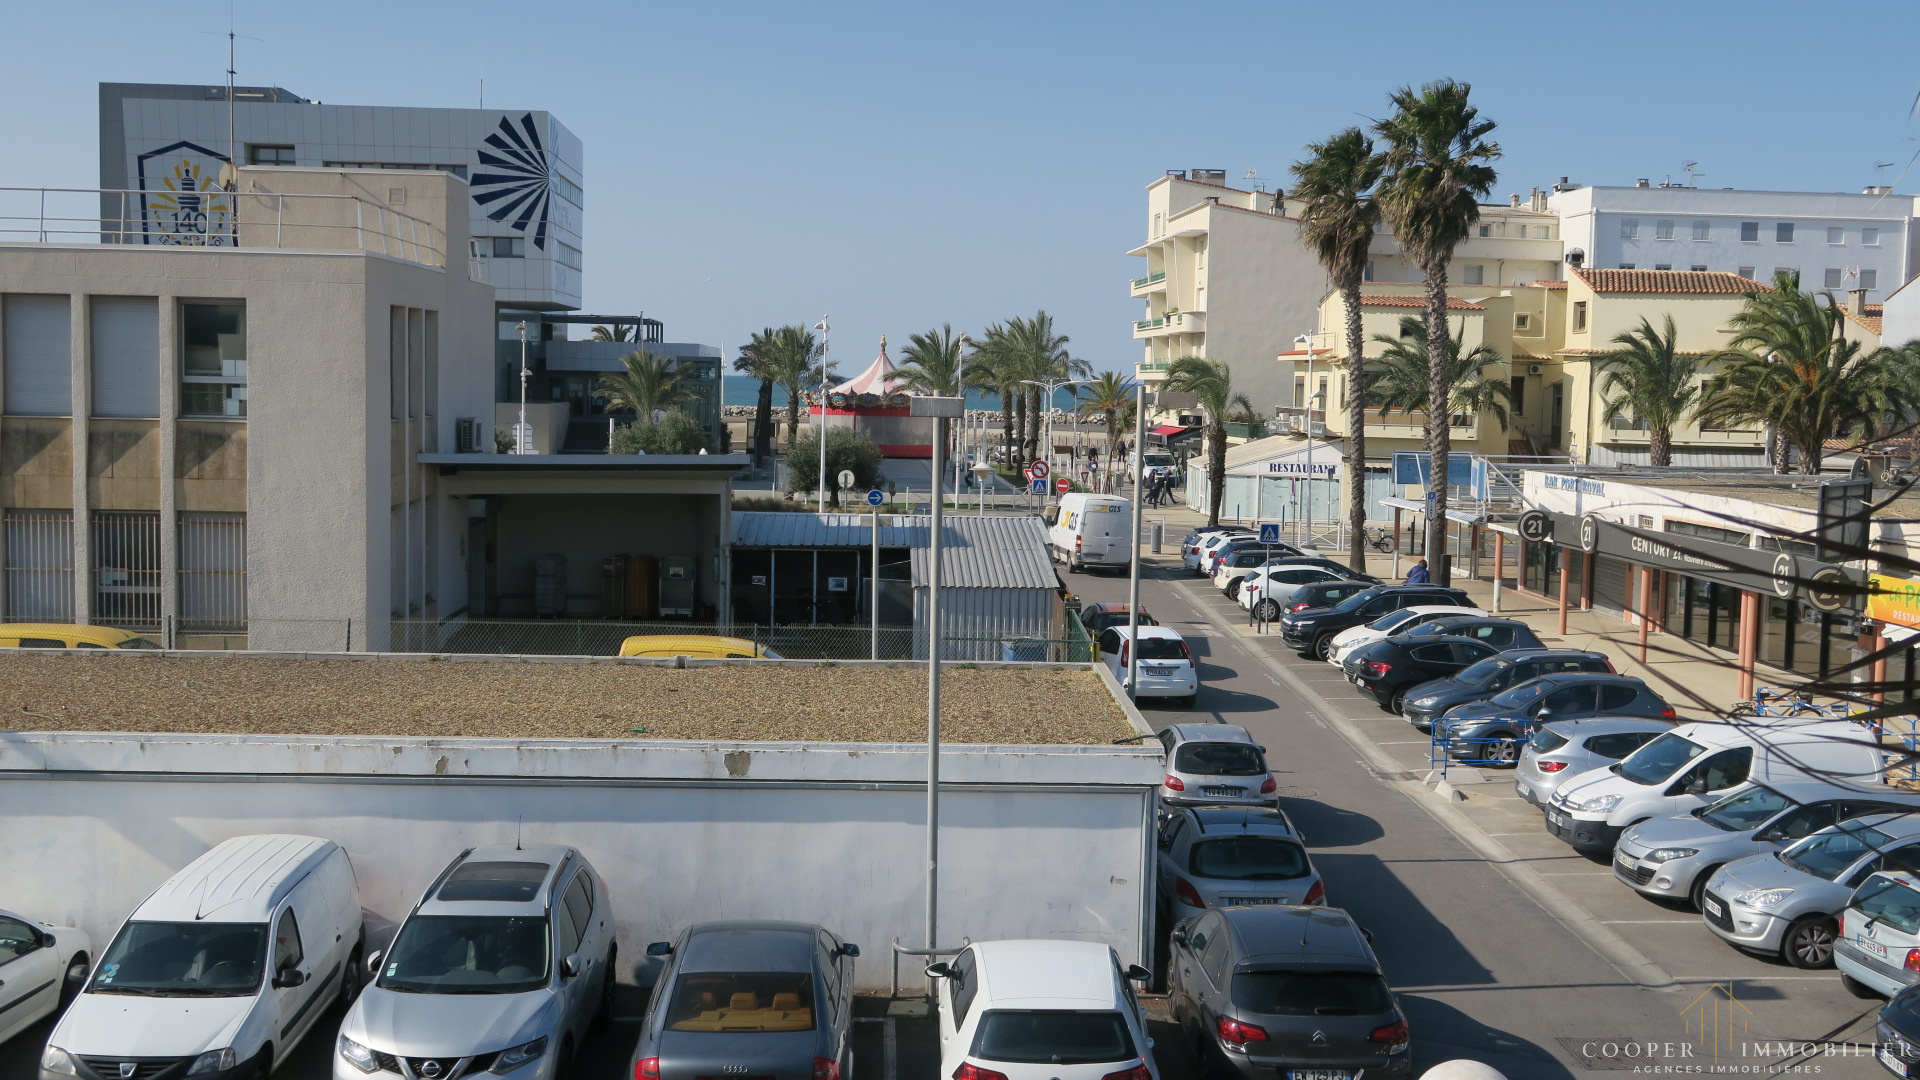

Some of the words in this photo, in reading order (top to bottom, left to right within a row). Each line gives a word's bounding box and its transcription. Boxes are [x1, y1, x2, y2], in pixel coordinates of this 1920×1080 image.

[170, 212, 207, 234] 140
[1269, 463, 1338, 474] RESTAURANT
[1544, 474, 1558, 489] BAR
[1561, 477, 1579, 492] PORT
[1582, 479, 1605, 497] ROYAL
[1889, 586, 1902, 602] LA
